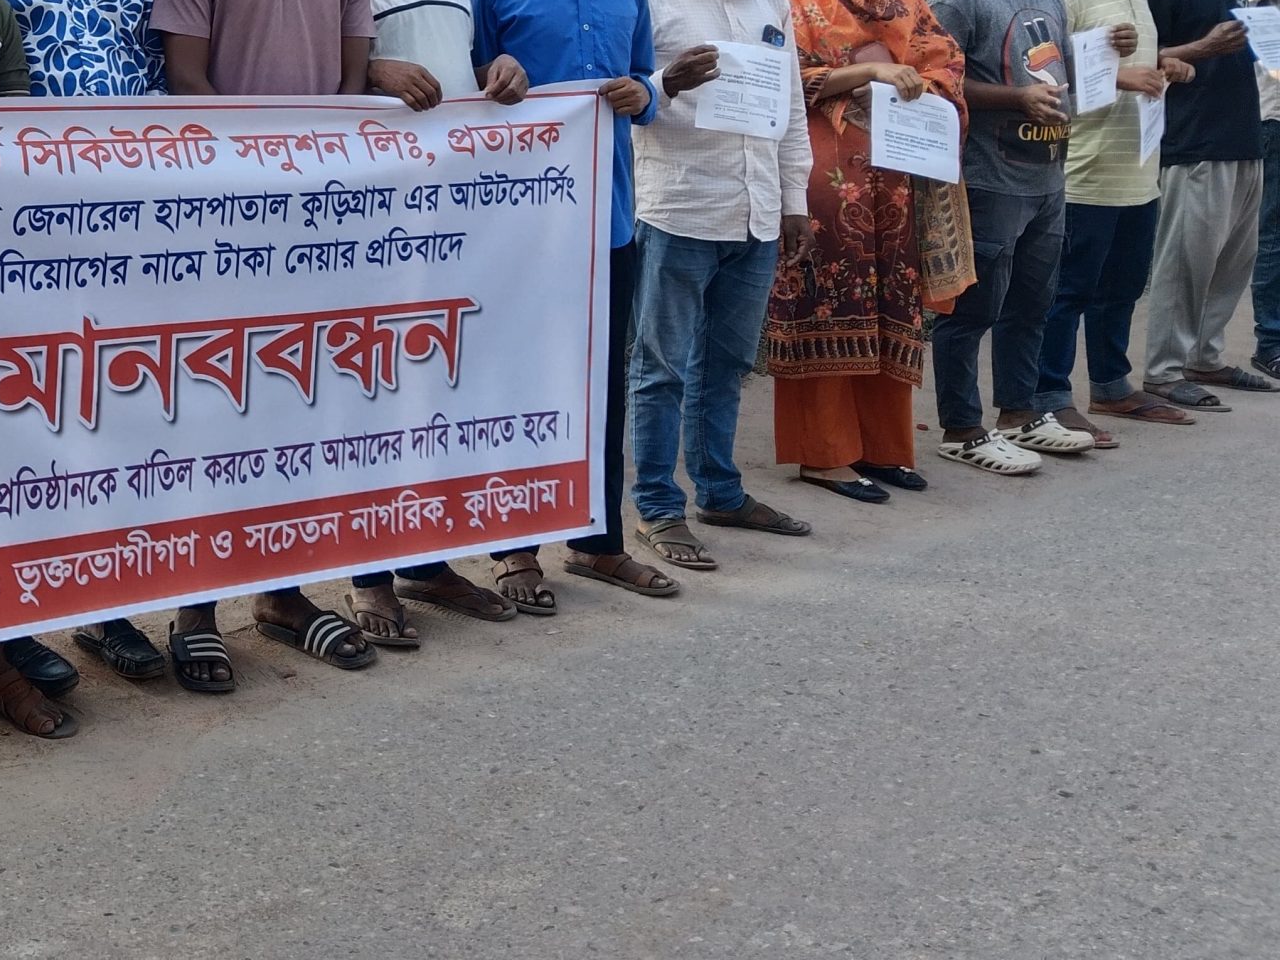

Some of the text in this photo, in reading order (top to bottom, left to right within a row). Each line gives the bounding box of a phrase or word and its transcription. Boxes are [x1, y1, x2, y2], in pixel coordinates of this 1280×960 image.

[12, 123, 219, 177] সিকিউরিটি
[228, 130, 349, 175] সলুশন
[448, 121, 565, 158] প্রতারক
[1018, 123, 1071, 141] GUINNES
[13, 198, 145, 237] জেনারেল
[153, 190, 292, 234] হাসপাতাল
[300, 180, 397, 230] কুড়িগ্রাম
[404, 184, 443, 213] এর
[448, 164, 577, 211] আউটসোর্সিং
[140, 249, 207, 285] নামে
[215, 238, 276, 279] টাকা
[285, 240, 360, 275] নেয়ার
[365, 226, 468, 269] প্রতিবাদে
[125, 449, 196, 500] বাতিল
[202, 448, 268, 488] করতে
[274, 442, 315, 483] হবে
[321, 430, 405, 472] আমাদের
[411, 412, 451, 460] দাবি
[456, 415, 517, 455] মানতে
[11, 529, 201, 607] ভুক্তভোগীগণ
[210, 529, 233, 560] ও
[243, 511, 344, 557] সচেতন
[349, 489, 454, 539] নাগরিক,
